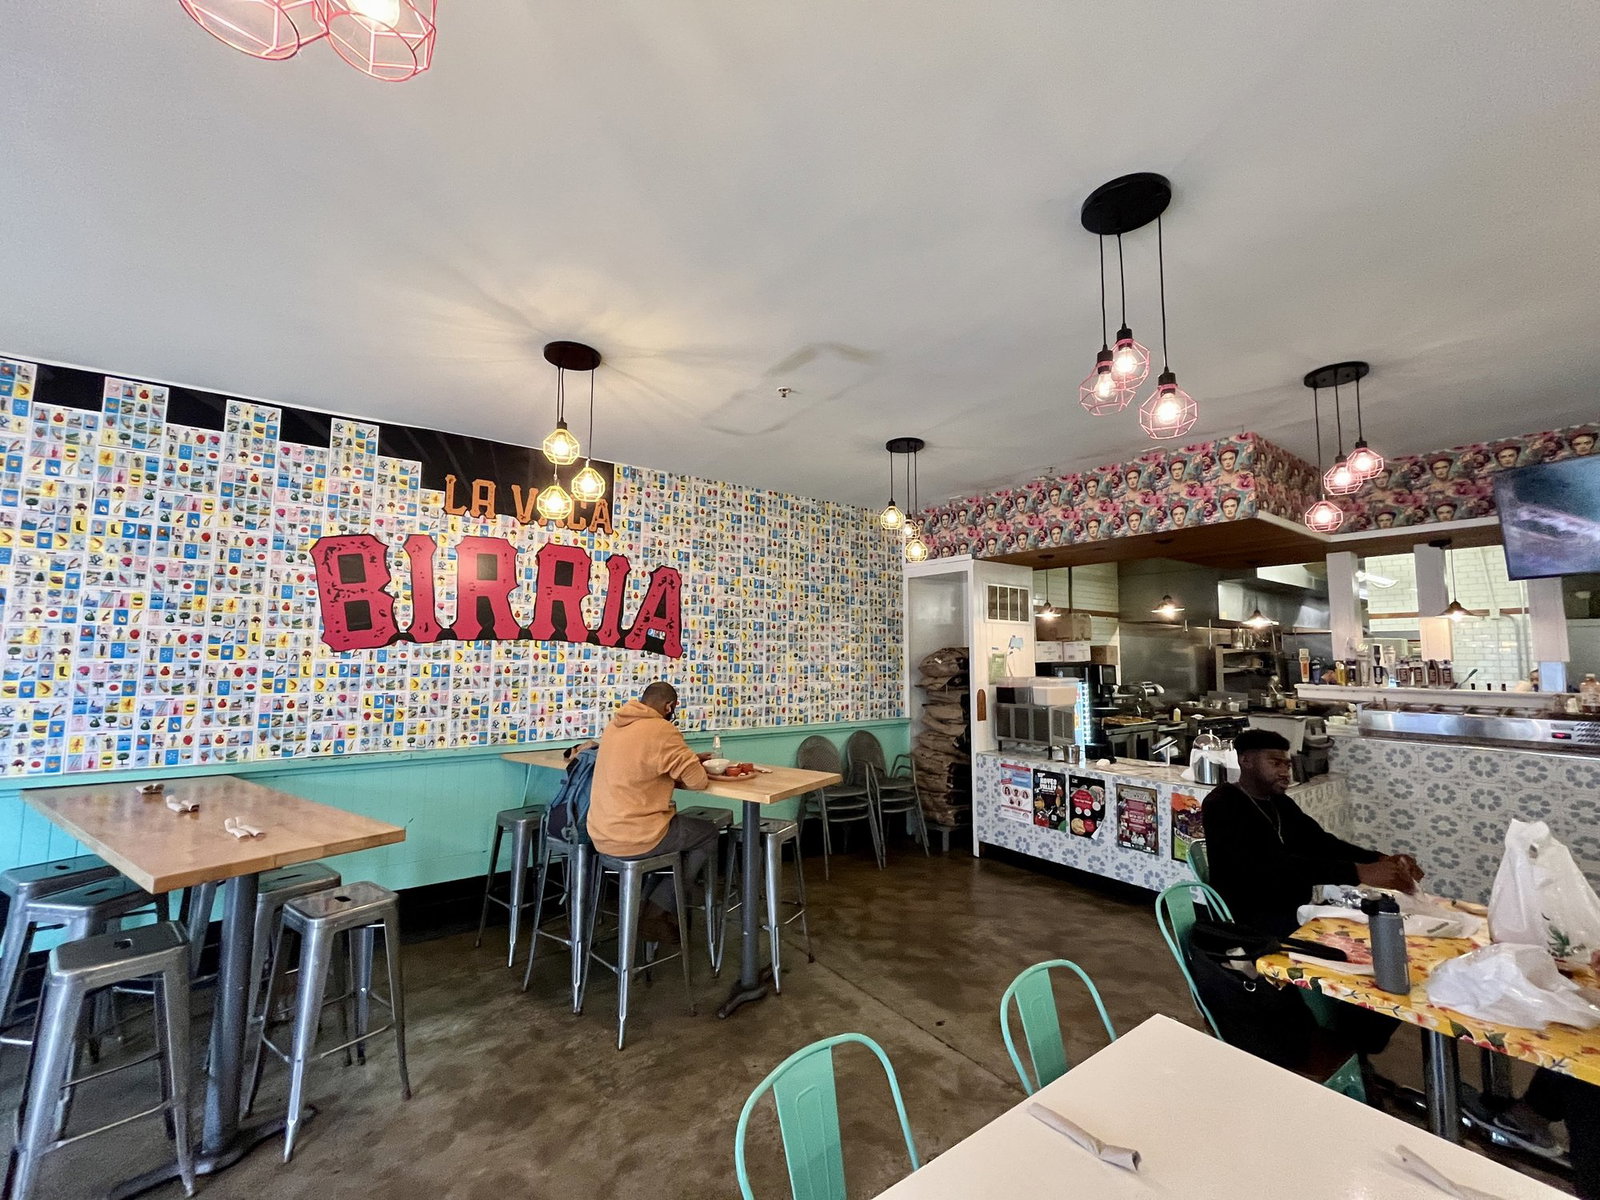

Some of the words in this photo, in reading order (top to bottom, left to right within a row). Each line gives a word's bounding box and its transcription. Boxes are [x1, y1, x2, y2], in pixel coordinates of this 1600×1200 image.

[443, 474, 497, 519] LA
[511, 484, 613, 534] VCA
[309, 534, 684, 659] BIRRIA
